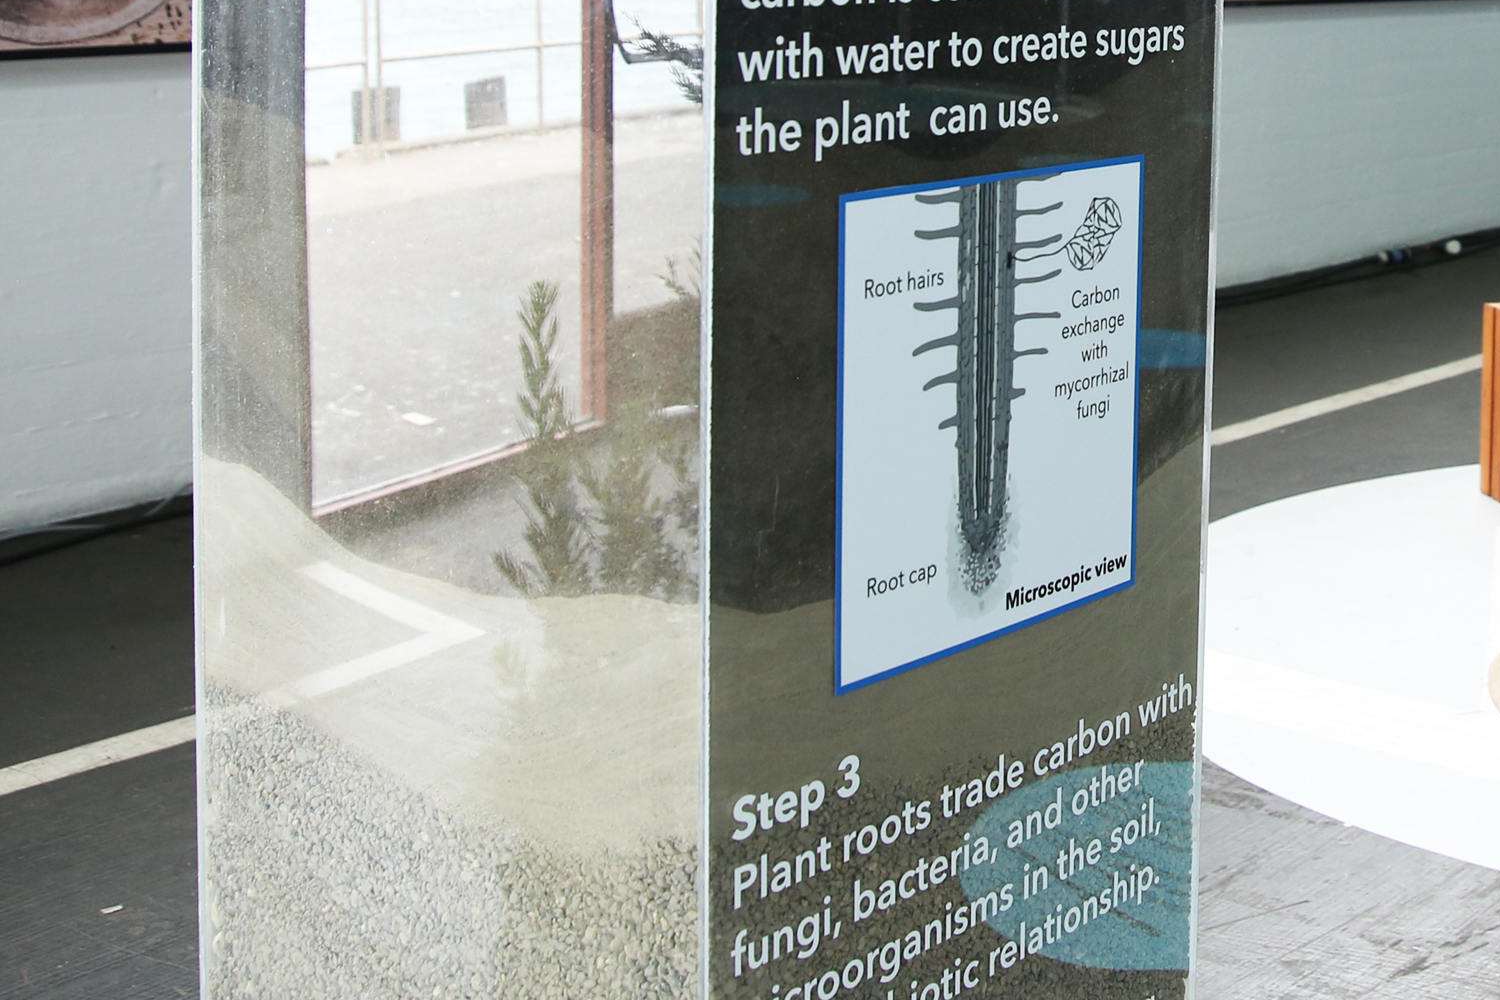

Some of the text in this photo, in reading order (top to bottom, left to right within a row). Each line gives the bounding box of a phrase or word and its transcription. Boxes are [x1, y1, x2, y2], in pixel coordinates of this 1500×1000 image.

[737, 21, 1186, 83] with water to create sugars
[736, 95, 1059, 162] the plant can use.
[864, 267, 945, 300] Root hairs
[1071, 284, 1120, 310] Carbon
[1061, 311, 1125, 340] exchange
[1081, 341, 1109, 363] with
[1054, 361, 1130, 400] mycorrhizal
[1076, 393, 1111, 422] fungi
[866, 562, 938, 599] Root cap
[1005, 553, 1128, 611] Microscopic view
[732, 754, 861, 841] Step 3
[733, 673, 1193, 910] Plant roots trade carbon with
[731, 757, 1145, 977] fungi, bacteria, and other
[772, 797, 1162, 1000] roorganisms in the soil,
[888, 863, 1161, 1000] iotic relationship.
